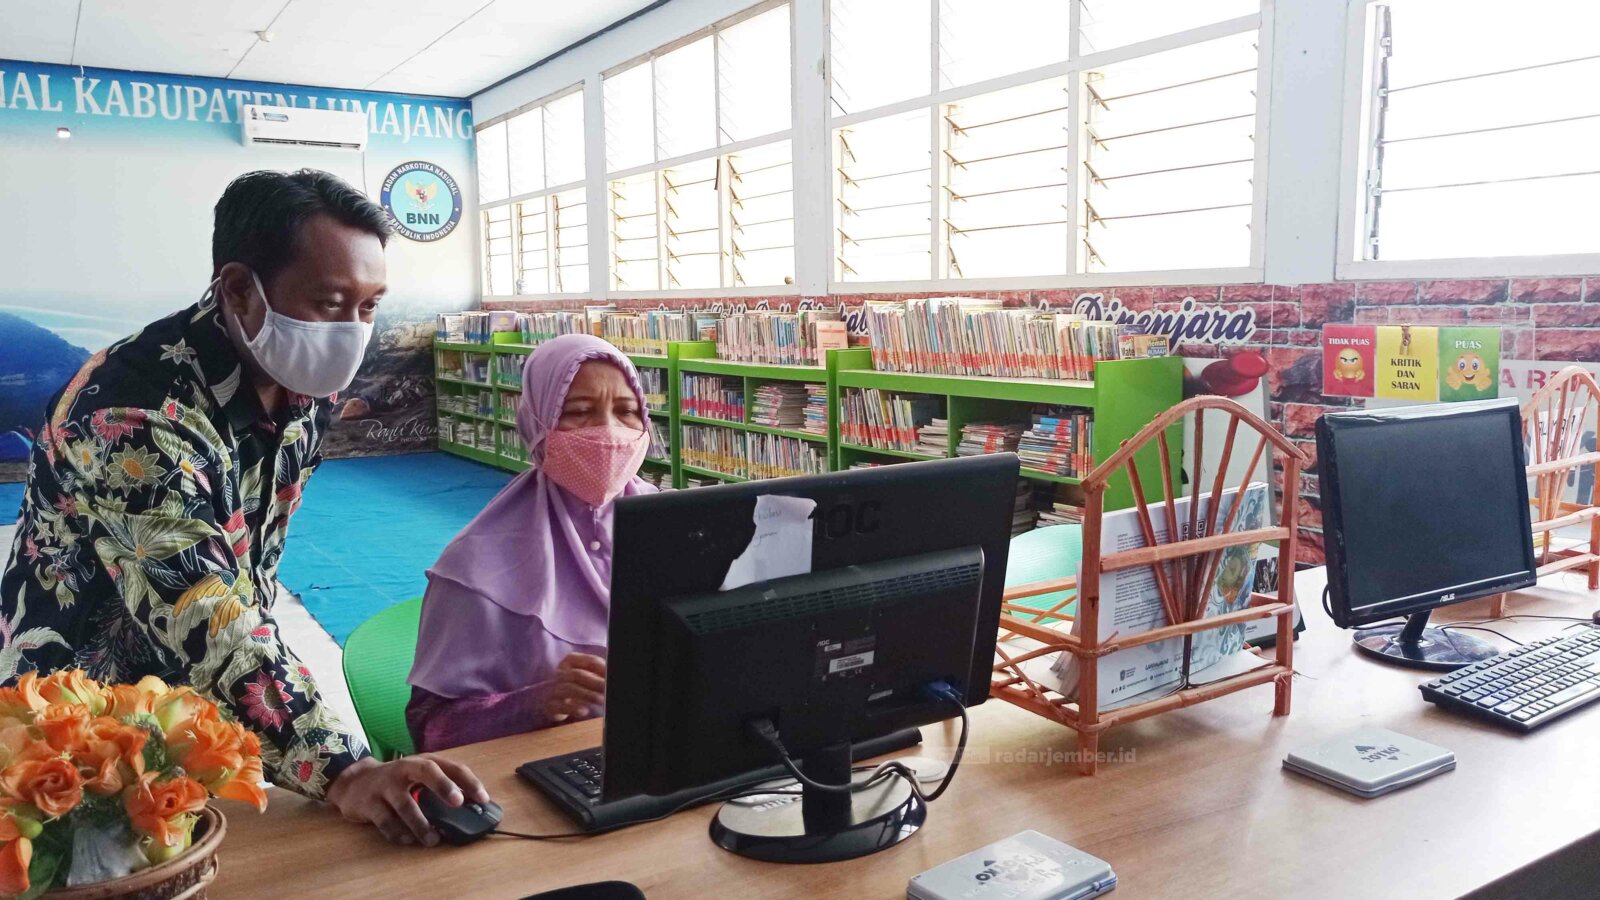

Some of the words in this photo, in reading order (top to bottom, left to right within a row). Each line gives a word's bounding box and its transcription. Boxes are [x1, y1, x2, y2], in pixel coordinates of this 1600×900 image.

[0, 70, 63, 112] AL
[383, 172, 399, 192] BADAN
[397, 162, 434, 175] NARKOTIKA
[435, 168, 459, 196] NASIONAL
[406, 212, 440, 225] BNN
[423, 220, 456, 241] INDONESIA
[1328, 337, 1350, 346] TIDAK
[1351, 338, 1370, 346] PUAS
[1455, 340, 1482, 350] PUAS
[1391, 358, 1422, 368] KRITIK
[1396, 369, 1416, 379] DAN
[1391, 380, 1421, 391] SARAN
[1439, 593, 1456, 603] ASUS
